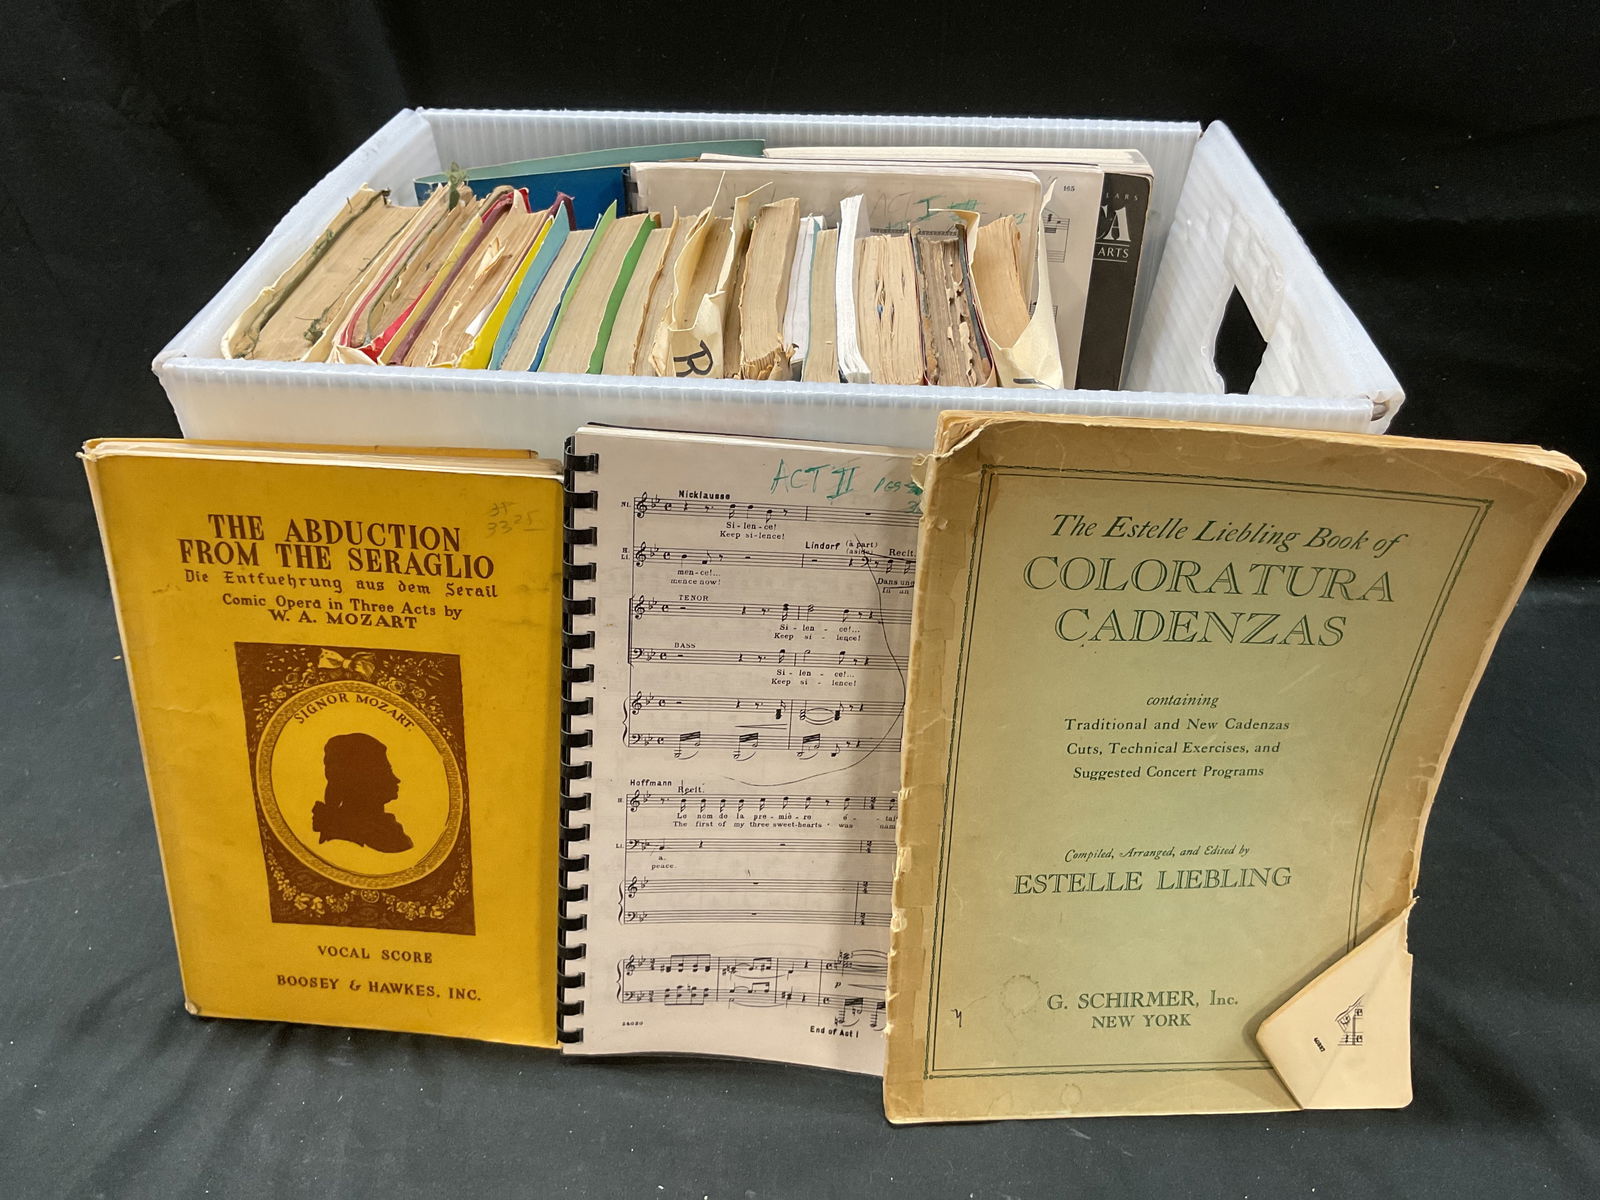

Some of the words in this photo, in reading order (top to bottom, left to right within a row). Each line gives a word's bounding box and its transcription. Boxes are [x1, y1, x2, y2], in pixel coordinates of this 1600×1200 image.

[1097, 246, 1129, 259] ARTS
[770, 458, 831, 495] ACT
[826, 465, 861, 501] II
[679, 490, 731, 500] Nicklausse
[208, 514, 264, 541] THE
[284, 518, 460, 551] ABDUCTION
[720, 531, 741, 540] Keep
[1050, 513, 1098, 538] The
[1102, 516, 1188, 541] Estelle
[1192, 520, 1300, 553] Liebling
[1302, 527, 1370, 552] Book
[1371, 534, 1408, 559] of
[805, 541, 841, 550] Lindorf
[177, 538, 260, 567] FROM
[275, 543, 331, 570] THE
[348, 547, 494, 579] SERAGLIO
[184, 569, 209, 582] Die
[224, 571, 343, 594] Entfuehrung
[356, 579, 385, 591] aus
[398, 580, 431, 594] dem
[445, 582, 498, 598] Serail
[1023, 555, 1394, 603] COLORATURA
[222, 593, 266, 607] Comic
[275, 595, 322, 610] Opera
[328, 597, 343, 610] in
[349, 598, 394, 613] Three
[401, 601, 436, 616] Acts
[444, 605, 463, 620] by
[268, 609, 291, 622] W.
[298, 610, 317, 623] A.
[326, 612, 417, 629] MOZART
[1054, 607, 1347, 647] CADENZAS
[771, 678, 791, 686] Keep
[294, 692, 350, 725] SIGNOR
[1146, 693, 1219, 708] containing
[1064, 718, 1147, 731] Traditional
[1153, 718, 1180, 730] and
[1185, 718, 1219, 730] New
[1225, 717, 1290, 730] Cadenzas
[1066, 742, 1103, 756] Cuts,
[1108, 742, 1178, 755] Technical
[1182, 742, 1249, 755] Exercises,
[1254, 741, 1281, 753] and
[1073, 766, 1141, 781] Suggested
[1146, 766, 1197, 778] Concert
[1203, 766, 1264, 780] Programs
[1064, 848, 1115, 863] Compiled,
[1119, 847, 1175, 861] Arranged,
[1179, 846, 1201, 856] and
[1203, 845, 1236, 856] Edited
[1238, 844, 1251, 857] by
[1014, 870, 1144, 895] ESTELLE
[1156, 867, 1293, 892] LIEBLING
[317, 945, 370, 960] VOCAL
[381, 948, 433, 964] SCORE
[276, 974, 340, 991] BOOSEY
[349, 979, 362, 991] &
[448, 987, 482, 1002] INC.
[1046, 994, 1068, 1011] G.
[1077, 989, 1200, 1011] SCHIRMER,
[1209, 989, 1239, 1008] Inc.
[810, 1025, 825, 1034] End
[828, 1028, 837, 1036] of
[1091, 1014, 1134, 1029] NEW
[1143, 1013, 1192, 1028] YORK
